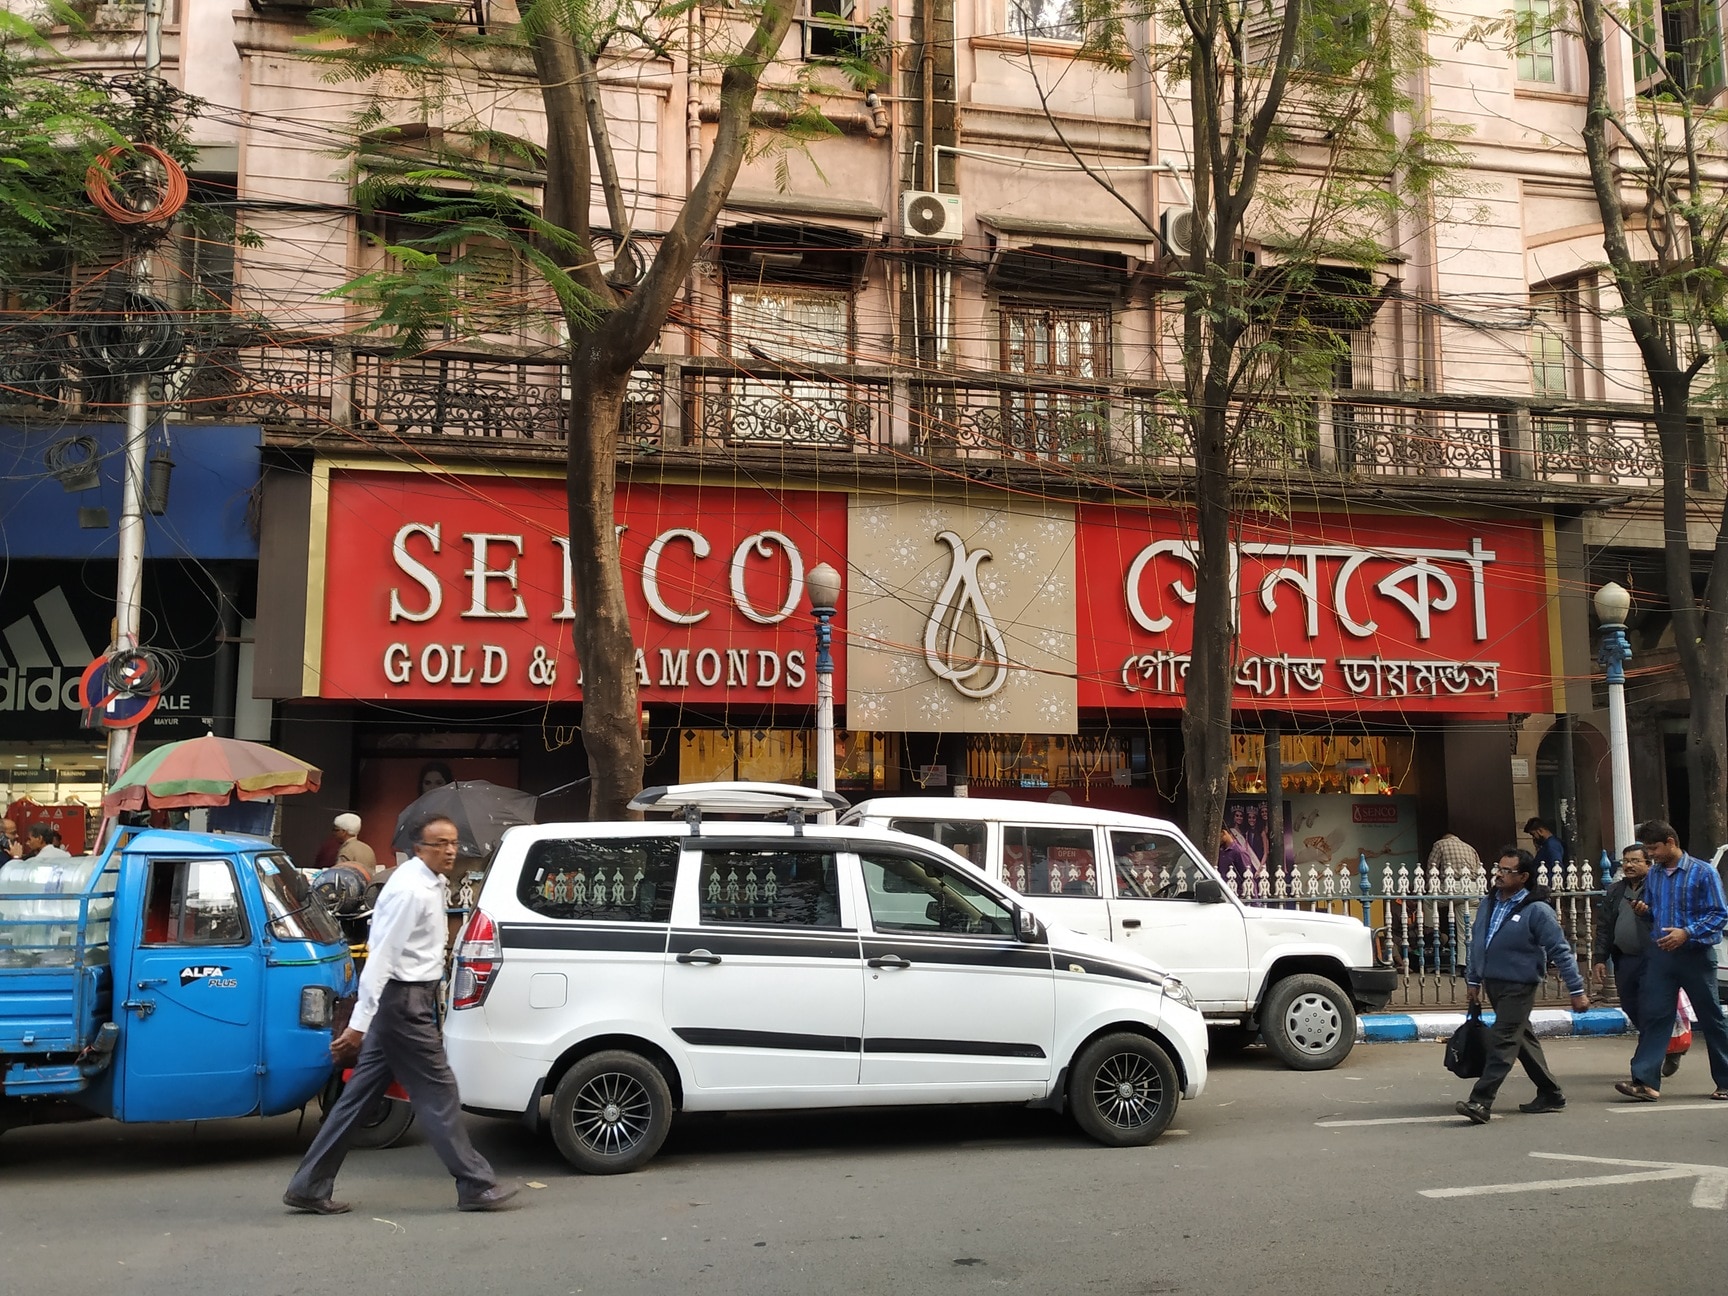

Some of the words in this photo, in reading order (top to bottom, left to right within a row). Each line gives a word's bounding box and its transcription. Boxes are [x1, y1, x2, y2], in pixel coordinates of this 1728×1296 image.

[383, 642, 509, 685] GOLD
[528, 645, 557, 686] &
[577, 646, 806, 688] AMONDS
[157, 695, 191, 710] ALE
[153, 717, 179, 725] MAYUR
[1362, 807, 1396, 817] SENCO
[1057, 850, 1076, 858] OPEN
[180, 967, 223, 977] ALFA
[208, 978, 238, 988] PLUS
